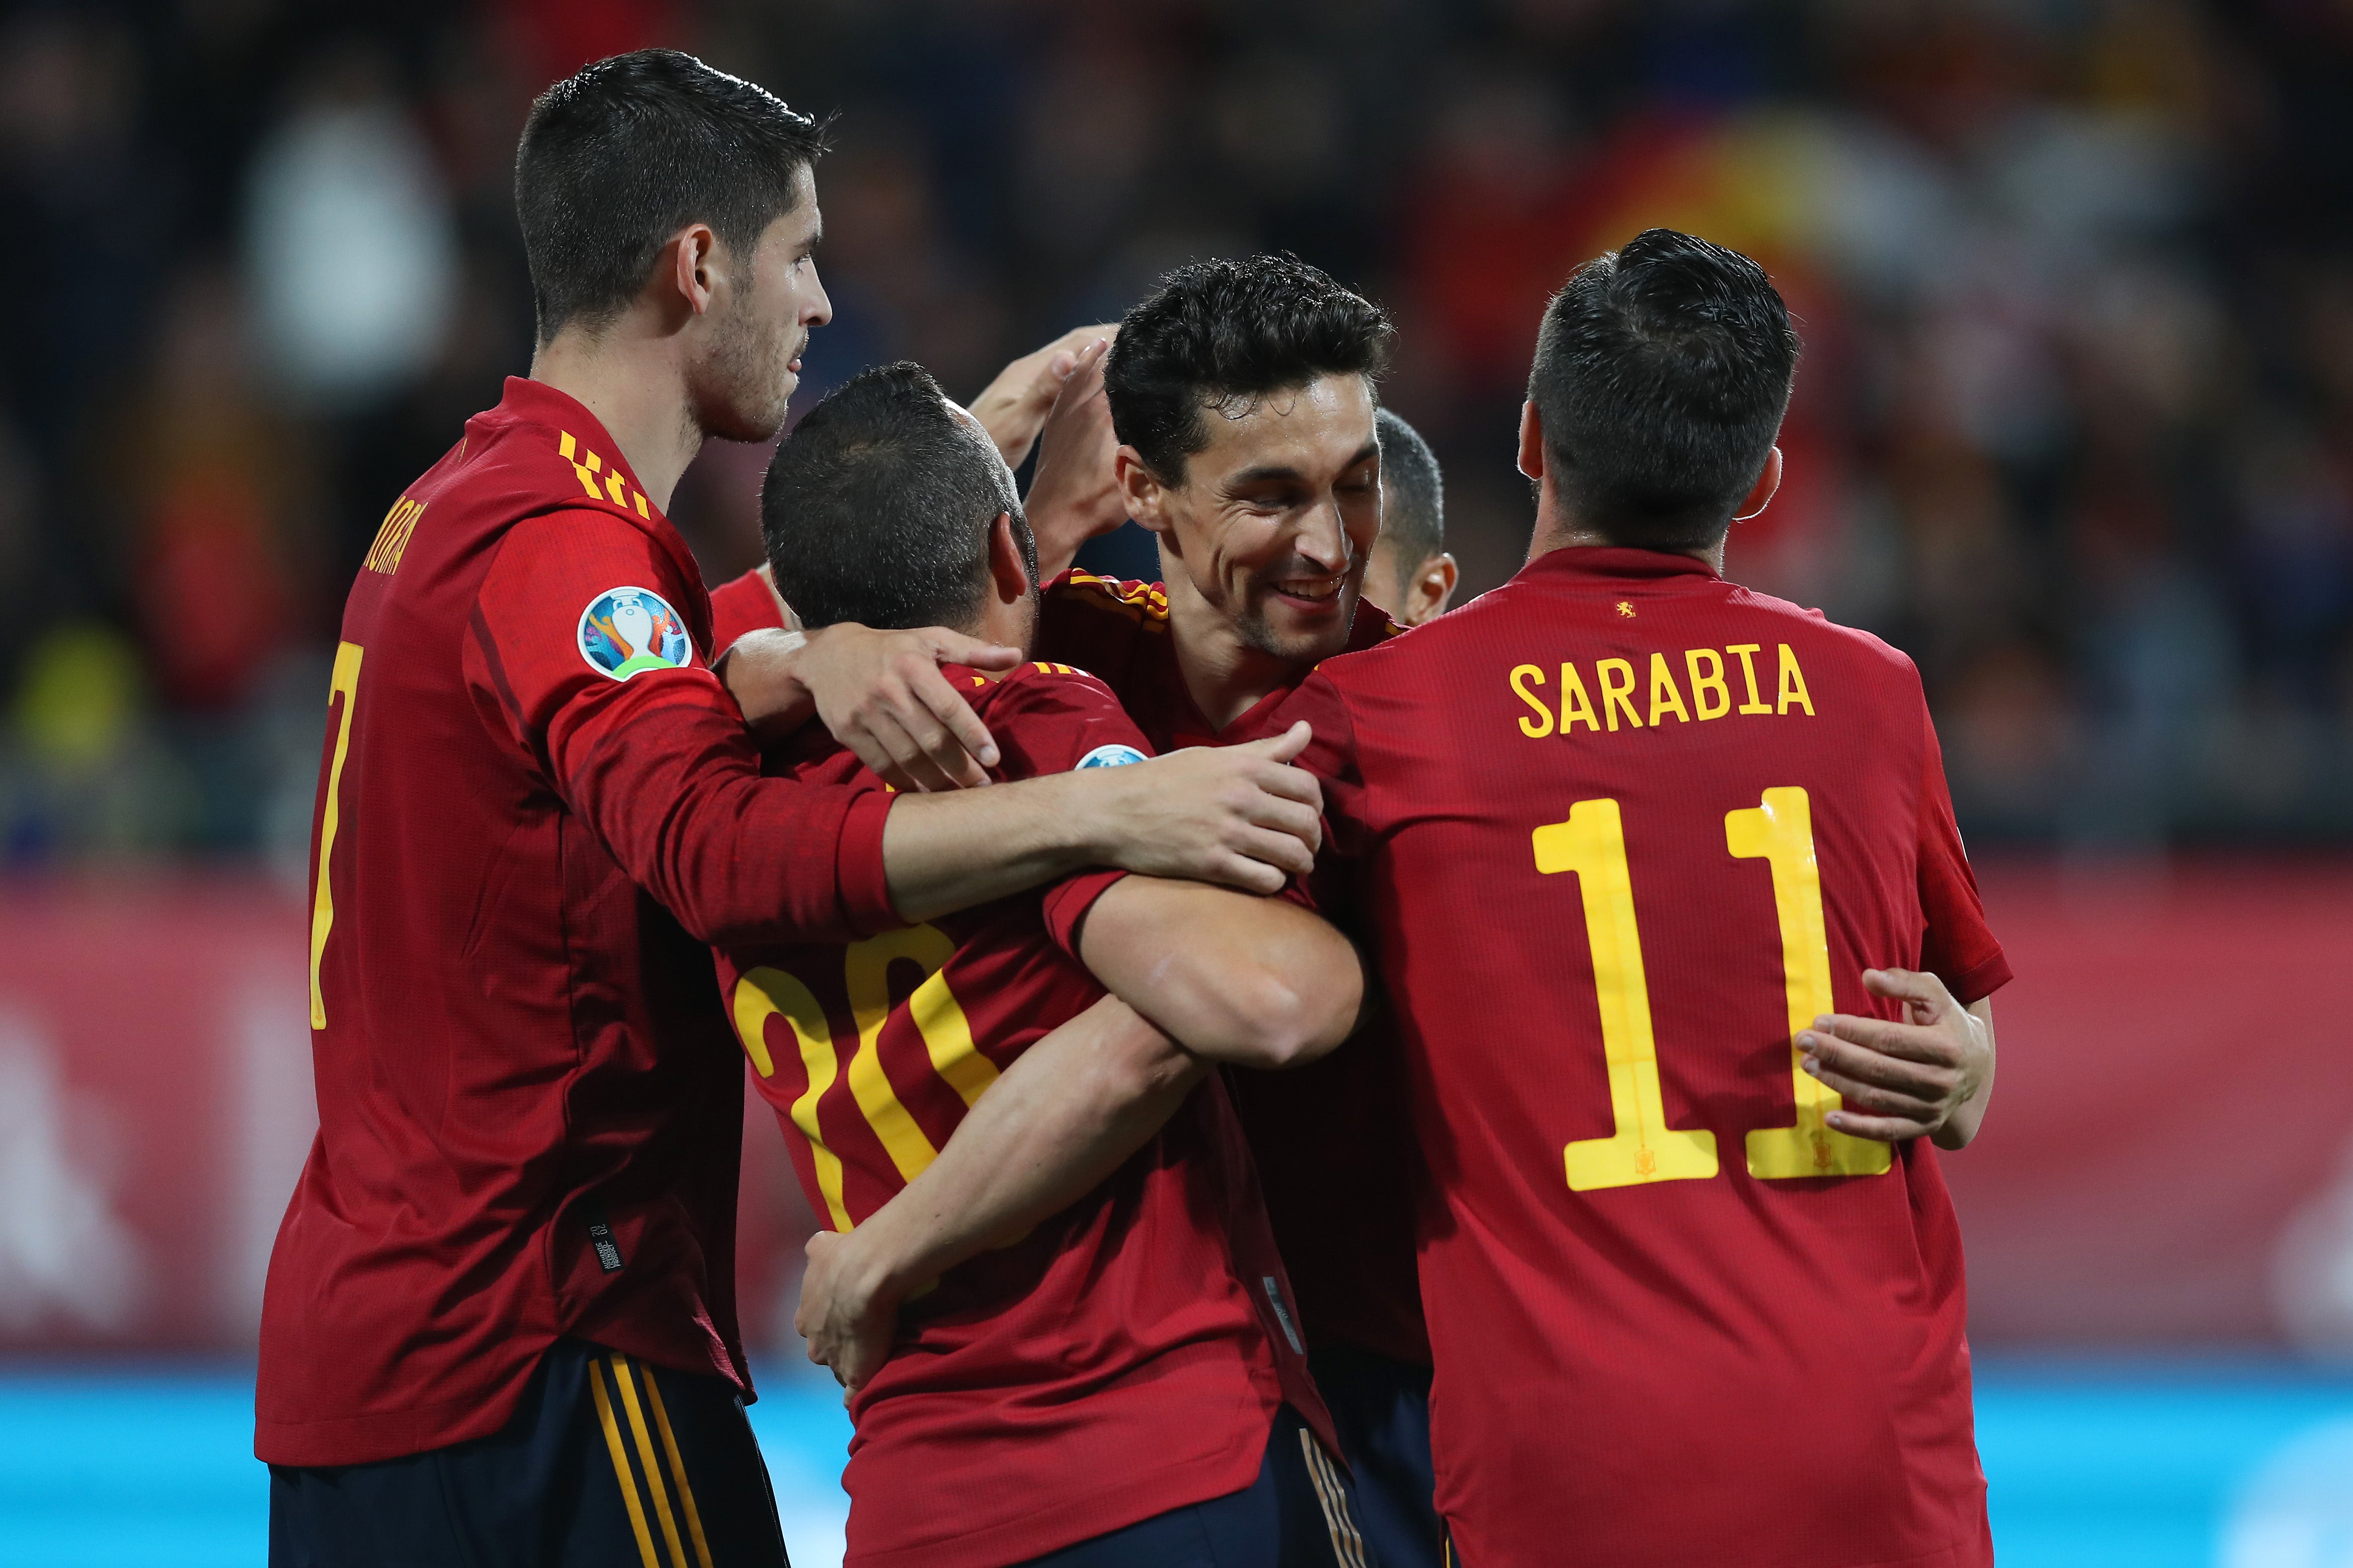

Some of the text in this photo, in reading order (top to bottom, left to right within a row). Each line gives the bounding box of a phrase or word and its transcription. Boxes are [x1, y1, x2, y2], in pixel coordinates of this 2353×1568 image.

[1509, 643, 1815, 738] SARABIA
[310, 640, 364, 1030] 7
[1531, 786, 1892, 1192] 11
[734, 922, 1037, 1301] 20
[596, 1243, 610, 1269] AUTHENTIC
[603, 1244, 615, 1269] LICENSED
[609, 1245, 621, 1267] PRODUCT
